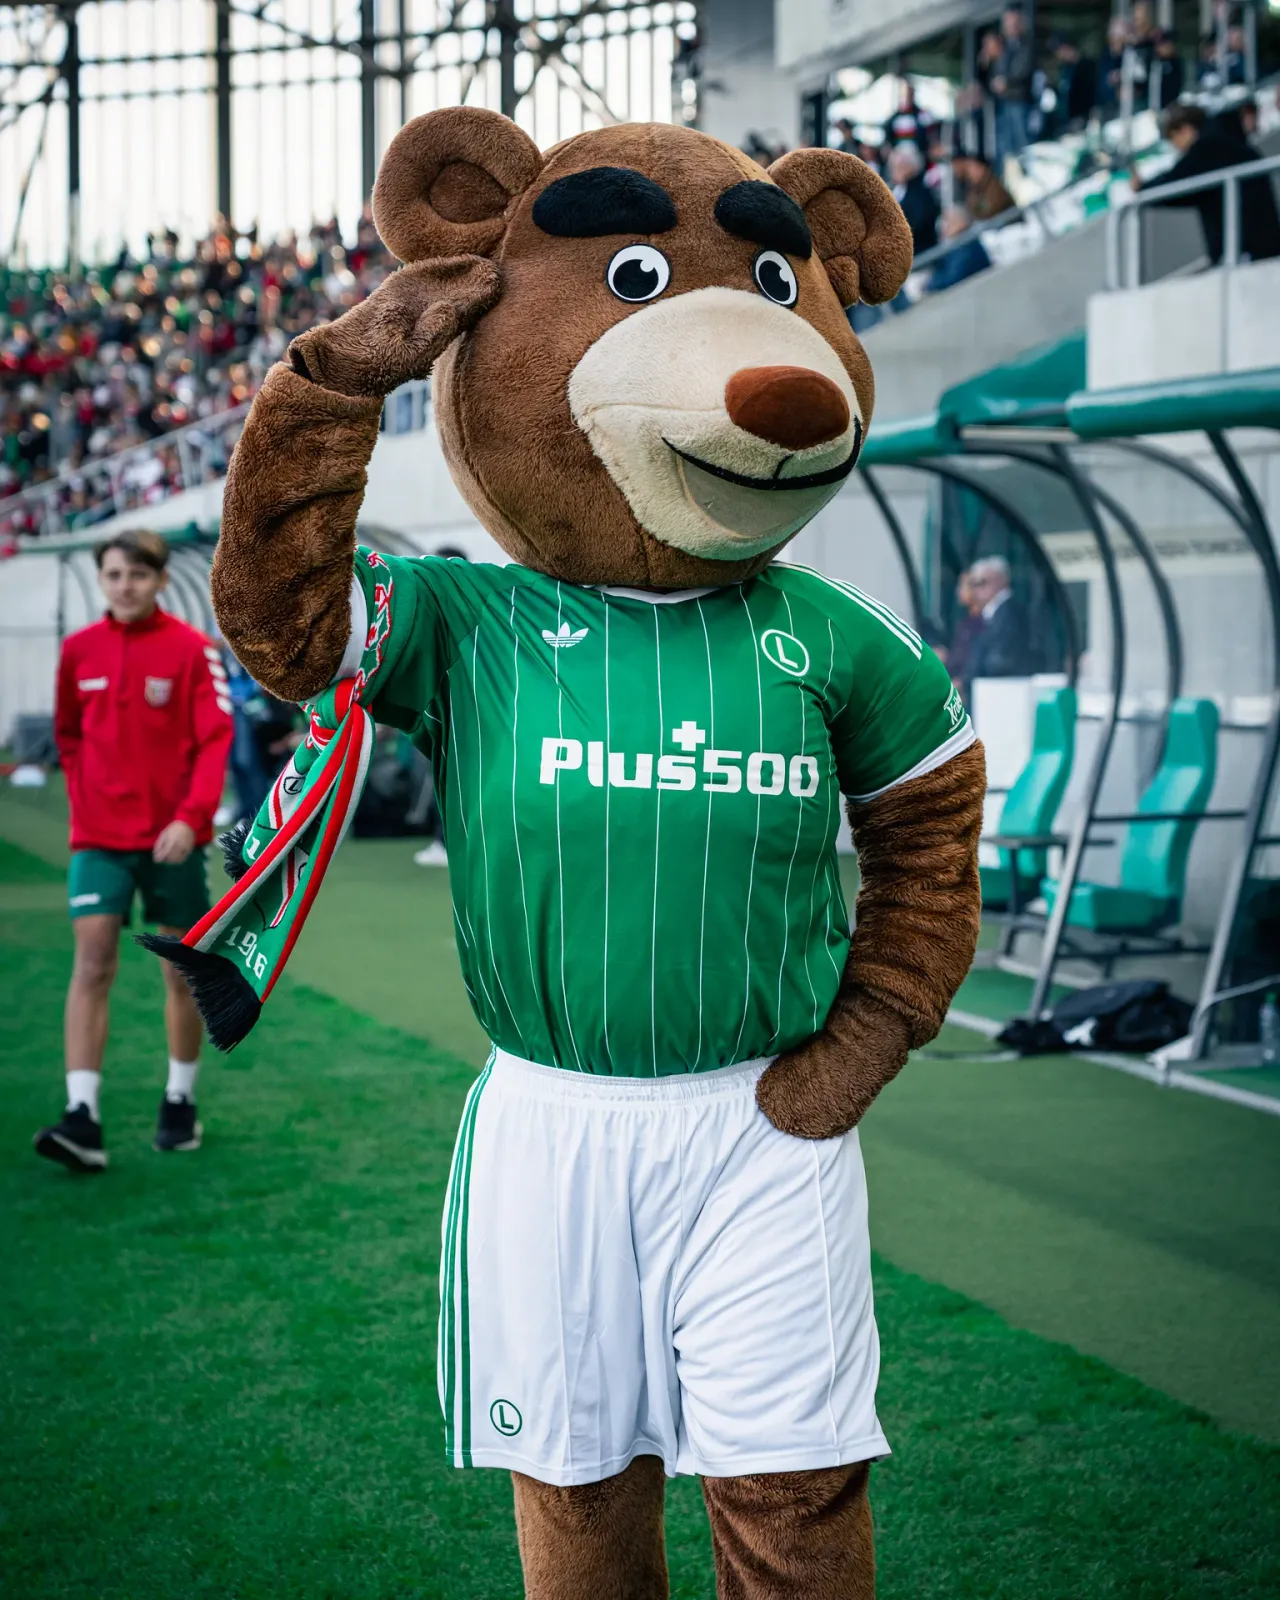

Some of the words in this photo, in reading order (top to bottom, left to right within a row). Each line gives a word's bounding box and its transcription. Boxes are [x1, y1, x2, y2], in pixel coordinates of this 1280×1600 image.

[775, 636, 799, 669] L
[539, 737, 819, 798] Plus500
[224, 925, 268, 980] 1916
[499, 1404, 514, 1430] L
